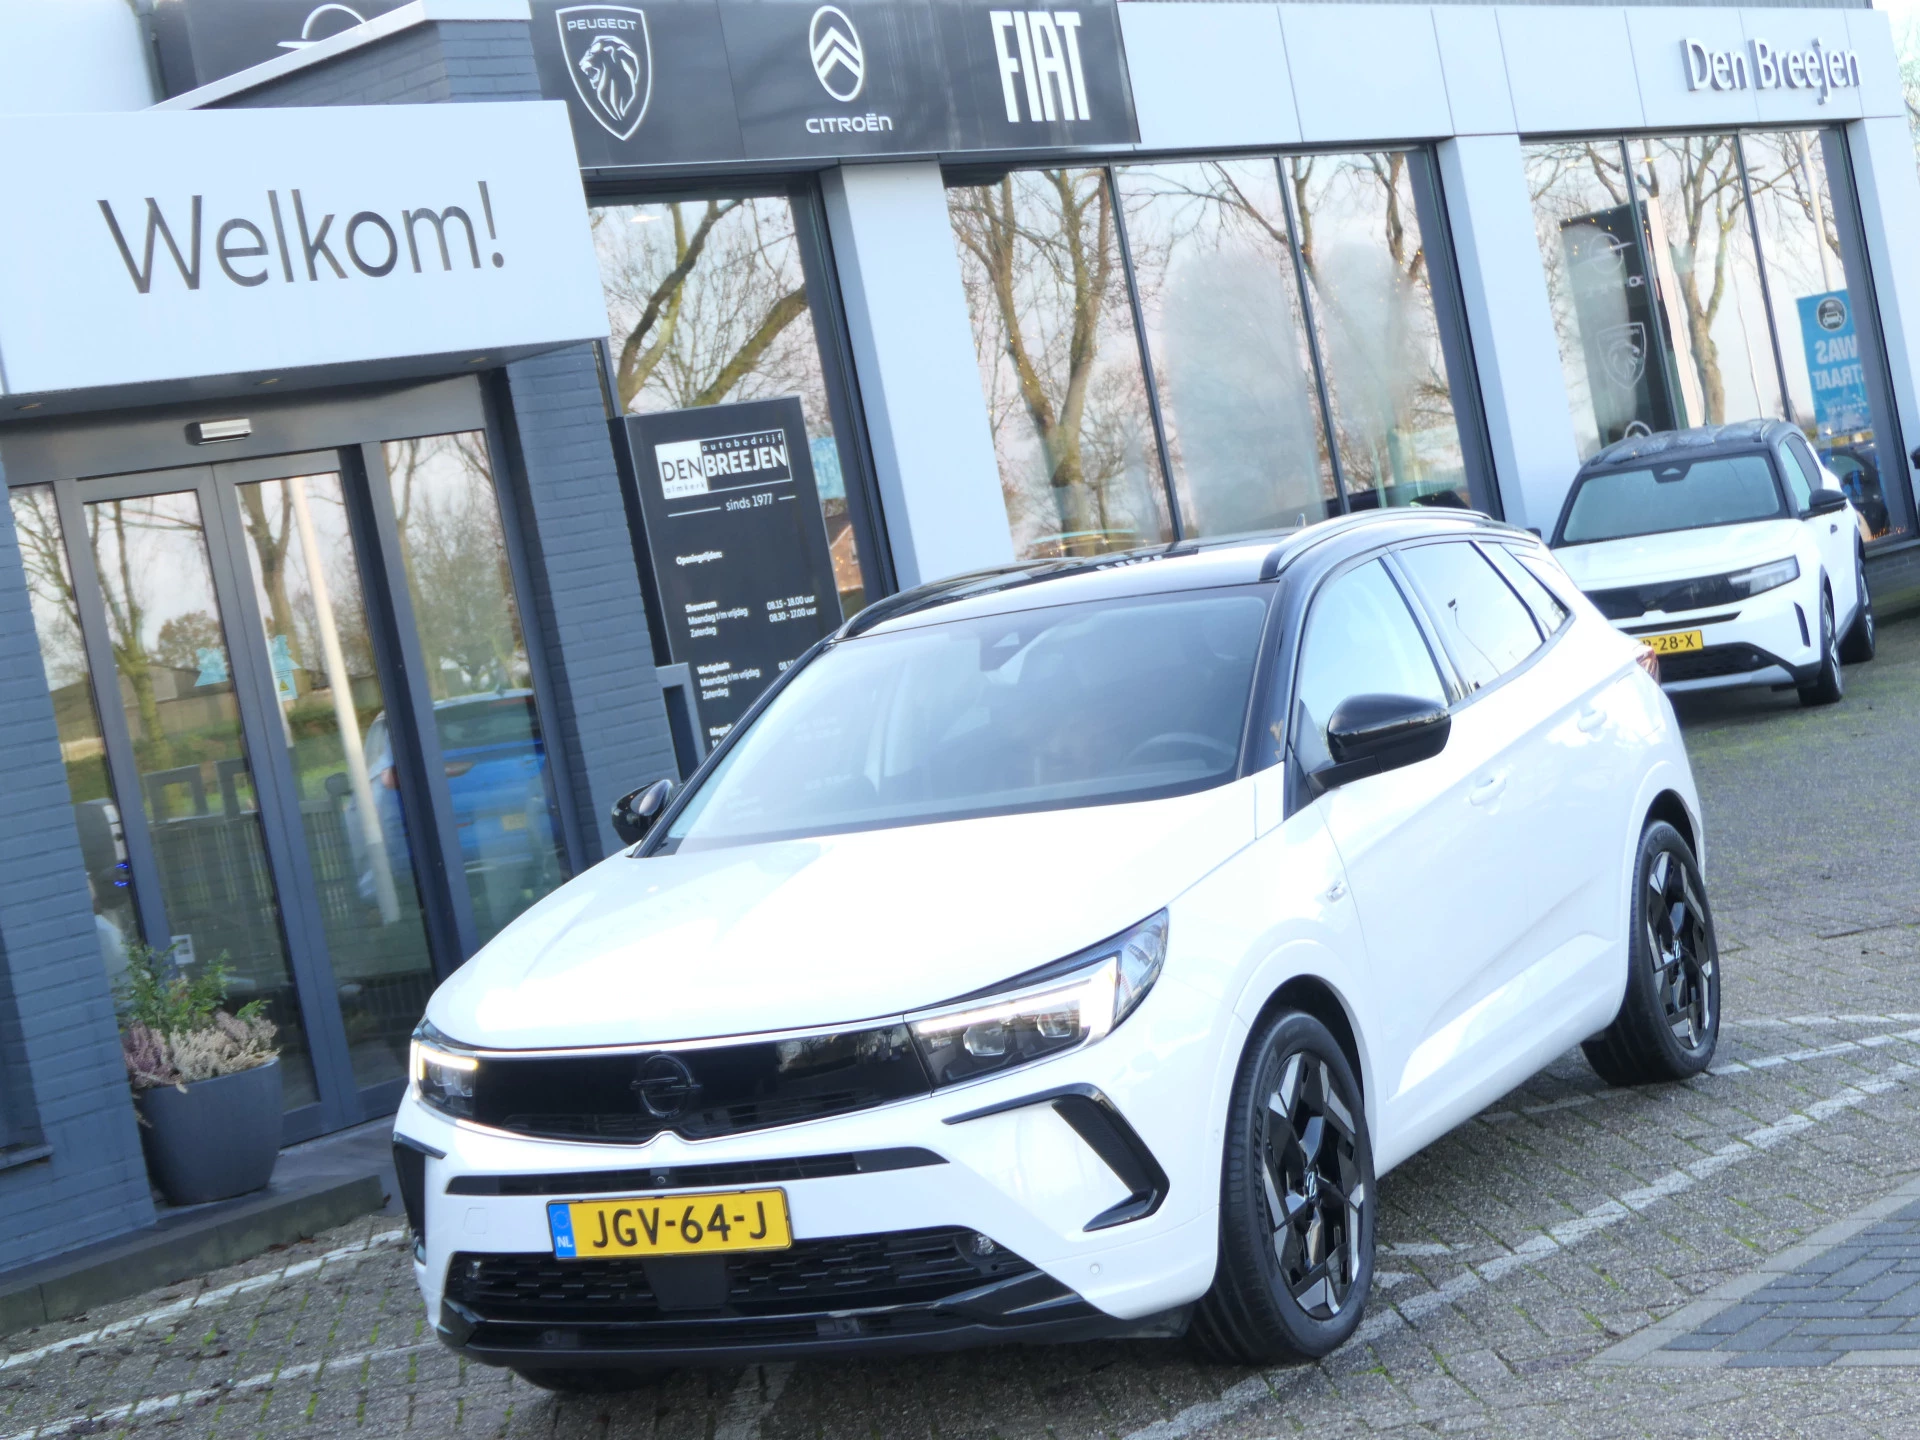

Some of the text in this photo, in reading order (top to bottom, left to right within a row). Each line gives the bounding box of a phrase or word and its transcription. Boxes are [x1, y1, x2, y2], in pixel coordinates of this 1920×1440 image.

[566, 18, 637, 31] PEUGEOT
[989, 10, 1091, 122] FIAT
[1679, 36, 1863, 106] Den Breejen
[97, 180, 506, 295] Welkom!
[702, 432, 783, 452] autobedrijf
[661, 445, 788, 482] DEN BREEJEN
[725, 493, 773, 511] sinds 1977
[687, 613, 716, 626] Maandag
[592, 1201, 767, 1249] JGV-64-J
[557, 1235, 573, 1248] NL
